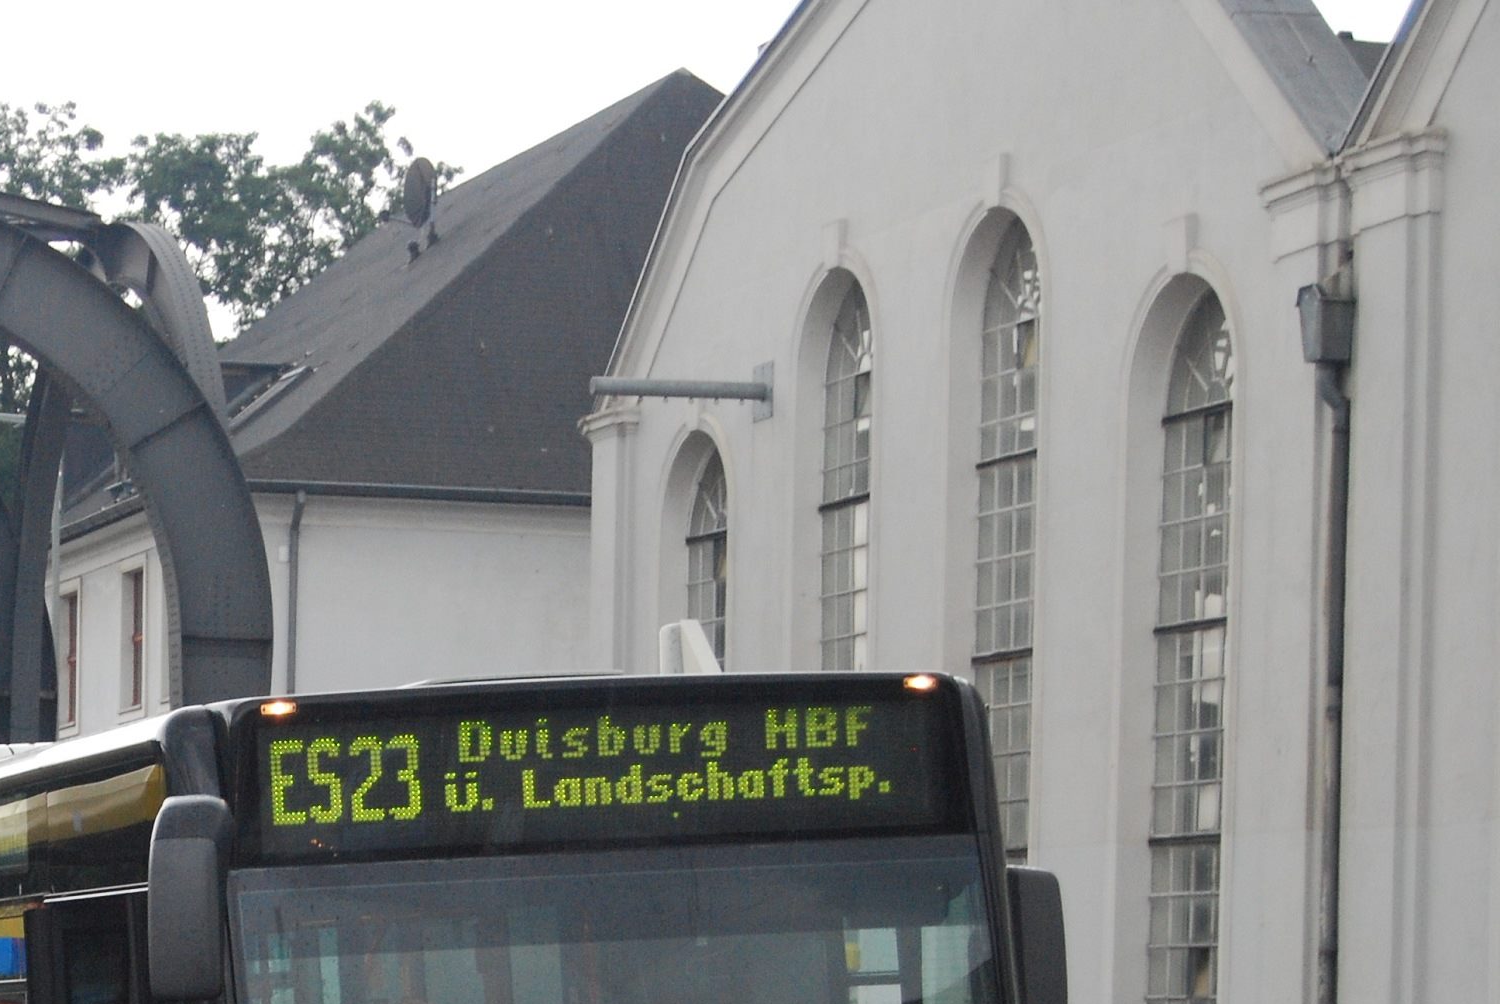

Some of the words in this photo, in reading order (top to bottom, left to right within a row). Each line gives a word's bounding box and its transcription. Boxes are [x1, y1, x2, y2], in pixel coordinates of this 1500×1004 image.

[270, 734, 422, 826] ES23
[458, 716, 728, 763] Duisburg
[764, 706, 873, 750] HBF
[444, 771, 493, 812] ü.
[522, 757, 891, 809] Landschaftsp.
